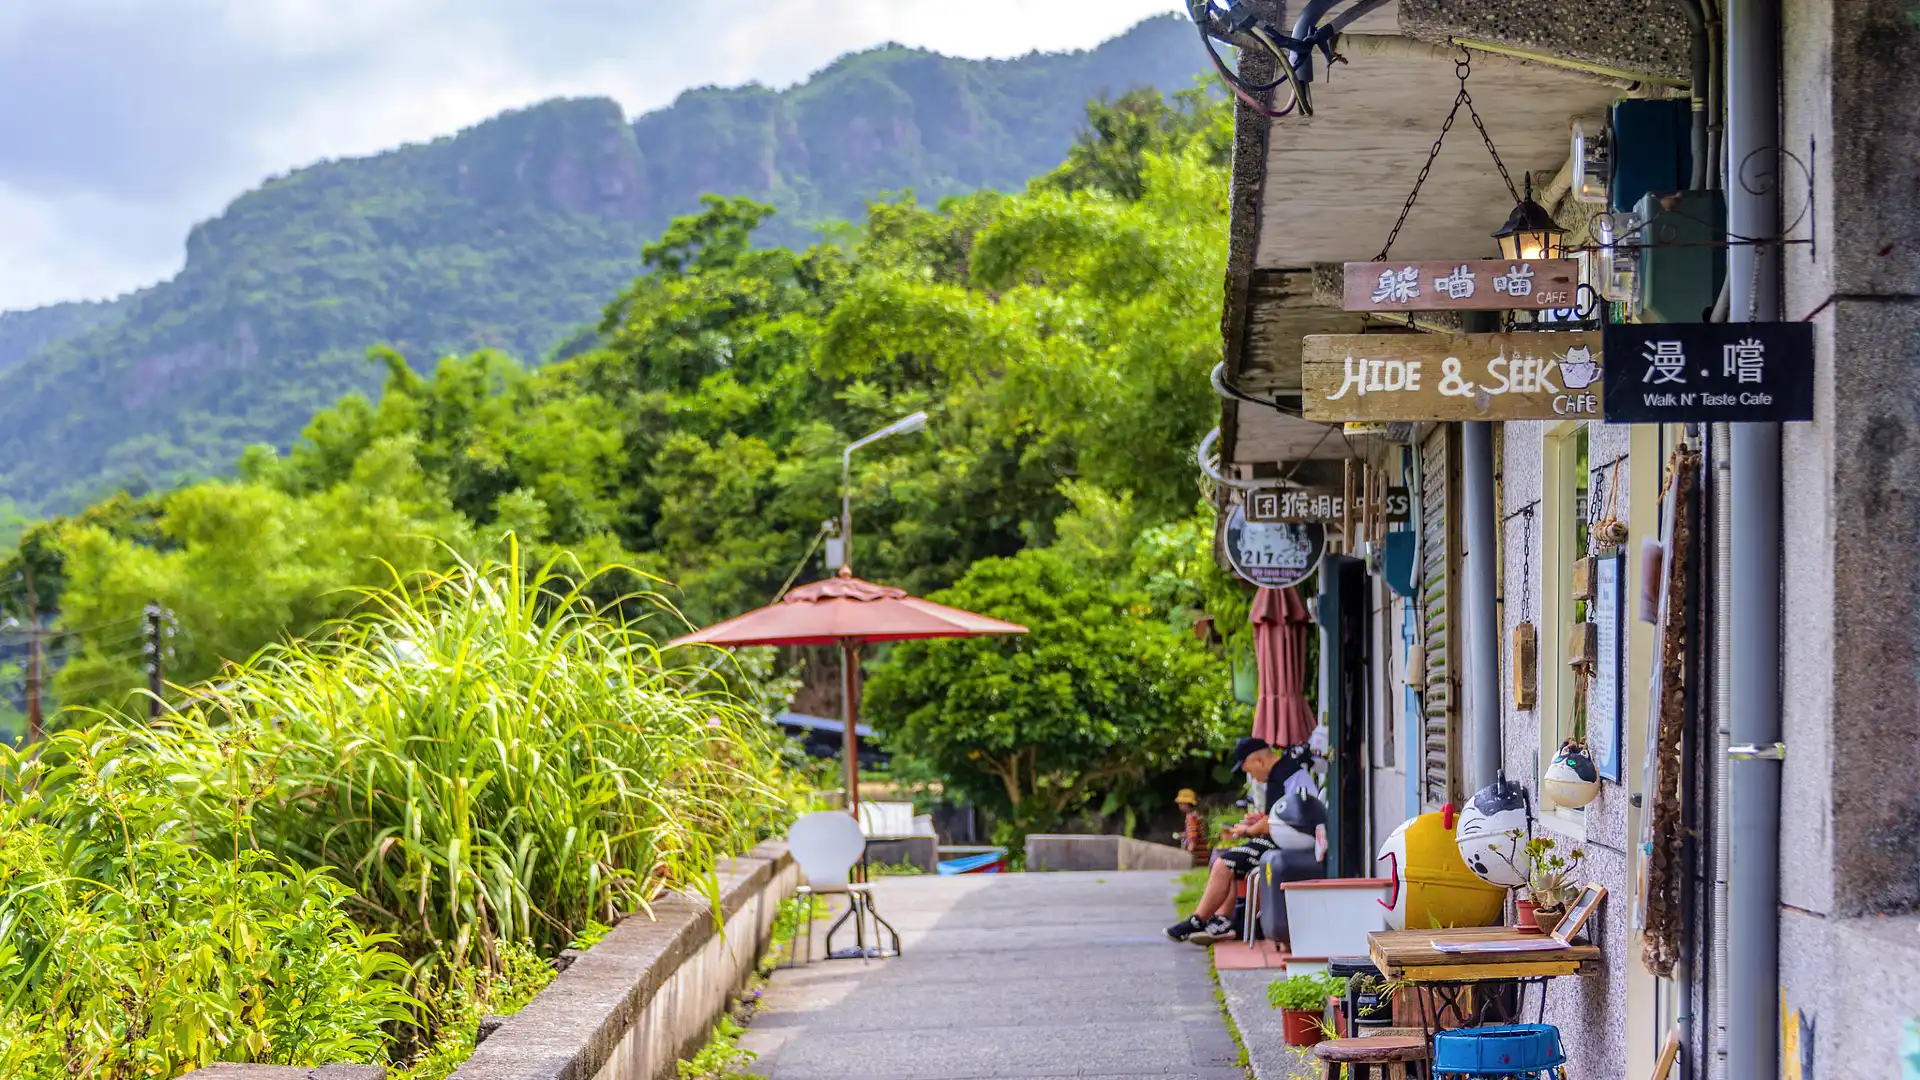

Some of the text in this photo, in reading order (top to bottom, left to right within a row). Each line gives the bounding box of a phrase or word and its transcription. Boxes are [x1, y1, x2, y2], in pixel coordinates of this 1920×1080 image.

[1371, 263, 1535, 304] 躲喵喵
[1536, 291, 1567, 304] CAFE
[1326, 354, 1560, 400] HIDE & SEEK
[1643, 393, 1678, 407] Walk
[1700, 393, 1737, 406] Taste
[1739, 392, 1773, 406] Cafe
[1243, 550, 1274, 565] 217
